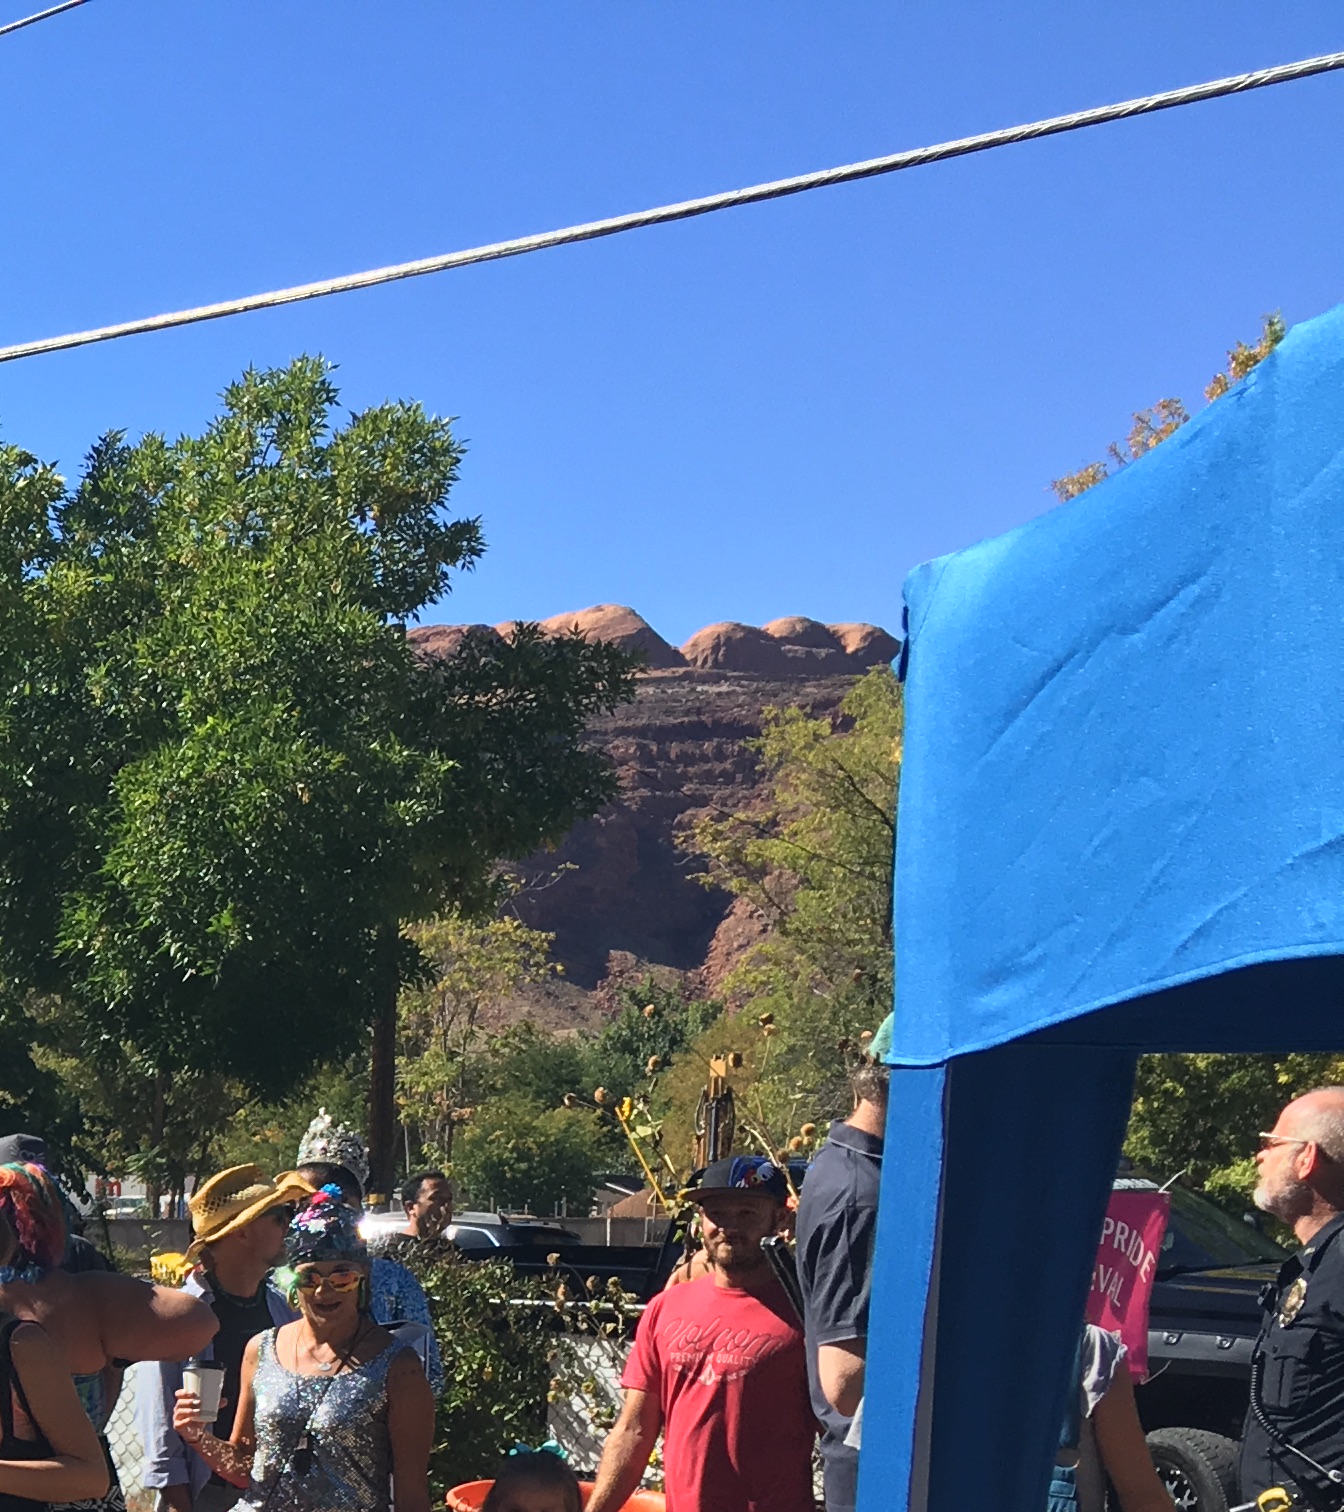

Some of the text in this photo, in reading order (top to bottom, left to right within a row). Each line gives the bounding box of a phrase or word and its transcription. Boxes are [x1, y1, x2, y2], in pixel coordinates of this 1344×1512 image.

[1100, 1217, 1155, 1283] PRIDE
[663, 1316, 783, 1355] Volcom
[716, 1353, 758, 1366] QUALITY
